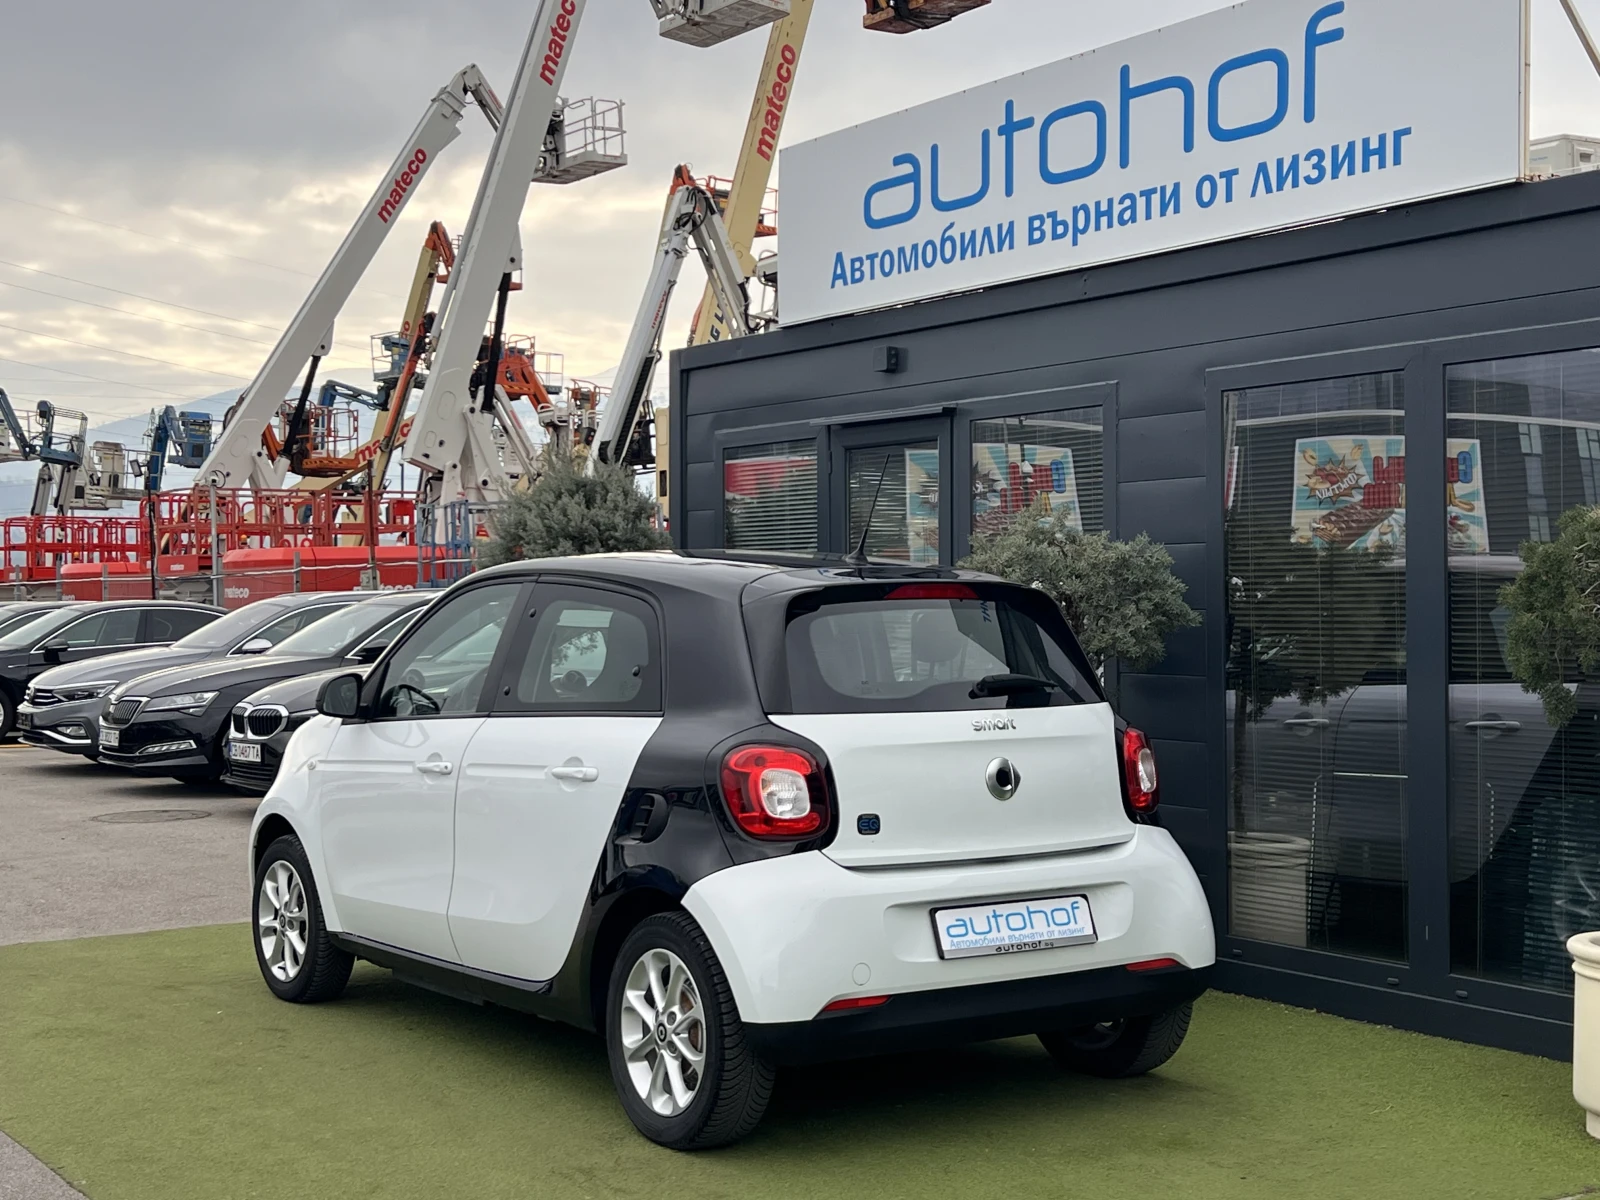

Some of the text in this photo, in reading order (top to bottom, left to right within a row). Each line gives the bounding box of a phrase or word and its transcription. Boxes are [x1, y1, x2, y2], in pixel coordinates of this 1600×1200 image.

[757, 44, 797, 162] mateco
[864, 2, 1345, 230] autohof
[377, 148, 427, 223] mateco
[831, 127, 1412, 288] Автомобили върнати от лизинг
[971, 716, 1017, 732] smart
[946, 901, 1080, 938] autohof
[950, 926, 1086, 949] Автомобили върнати от лизинг
